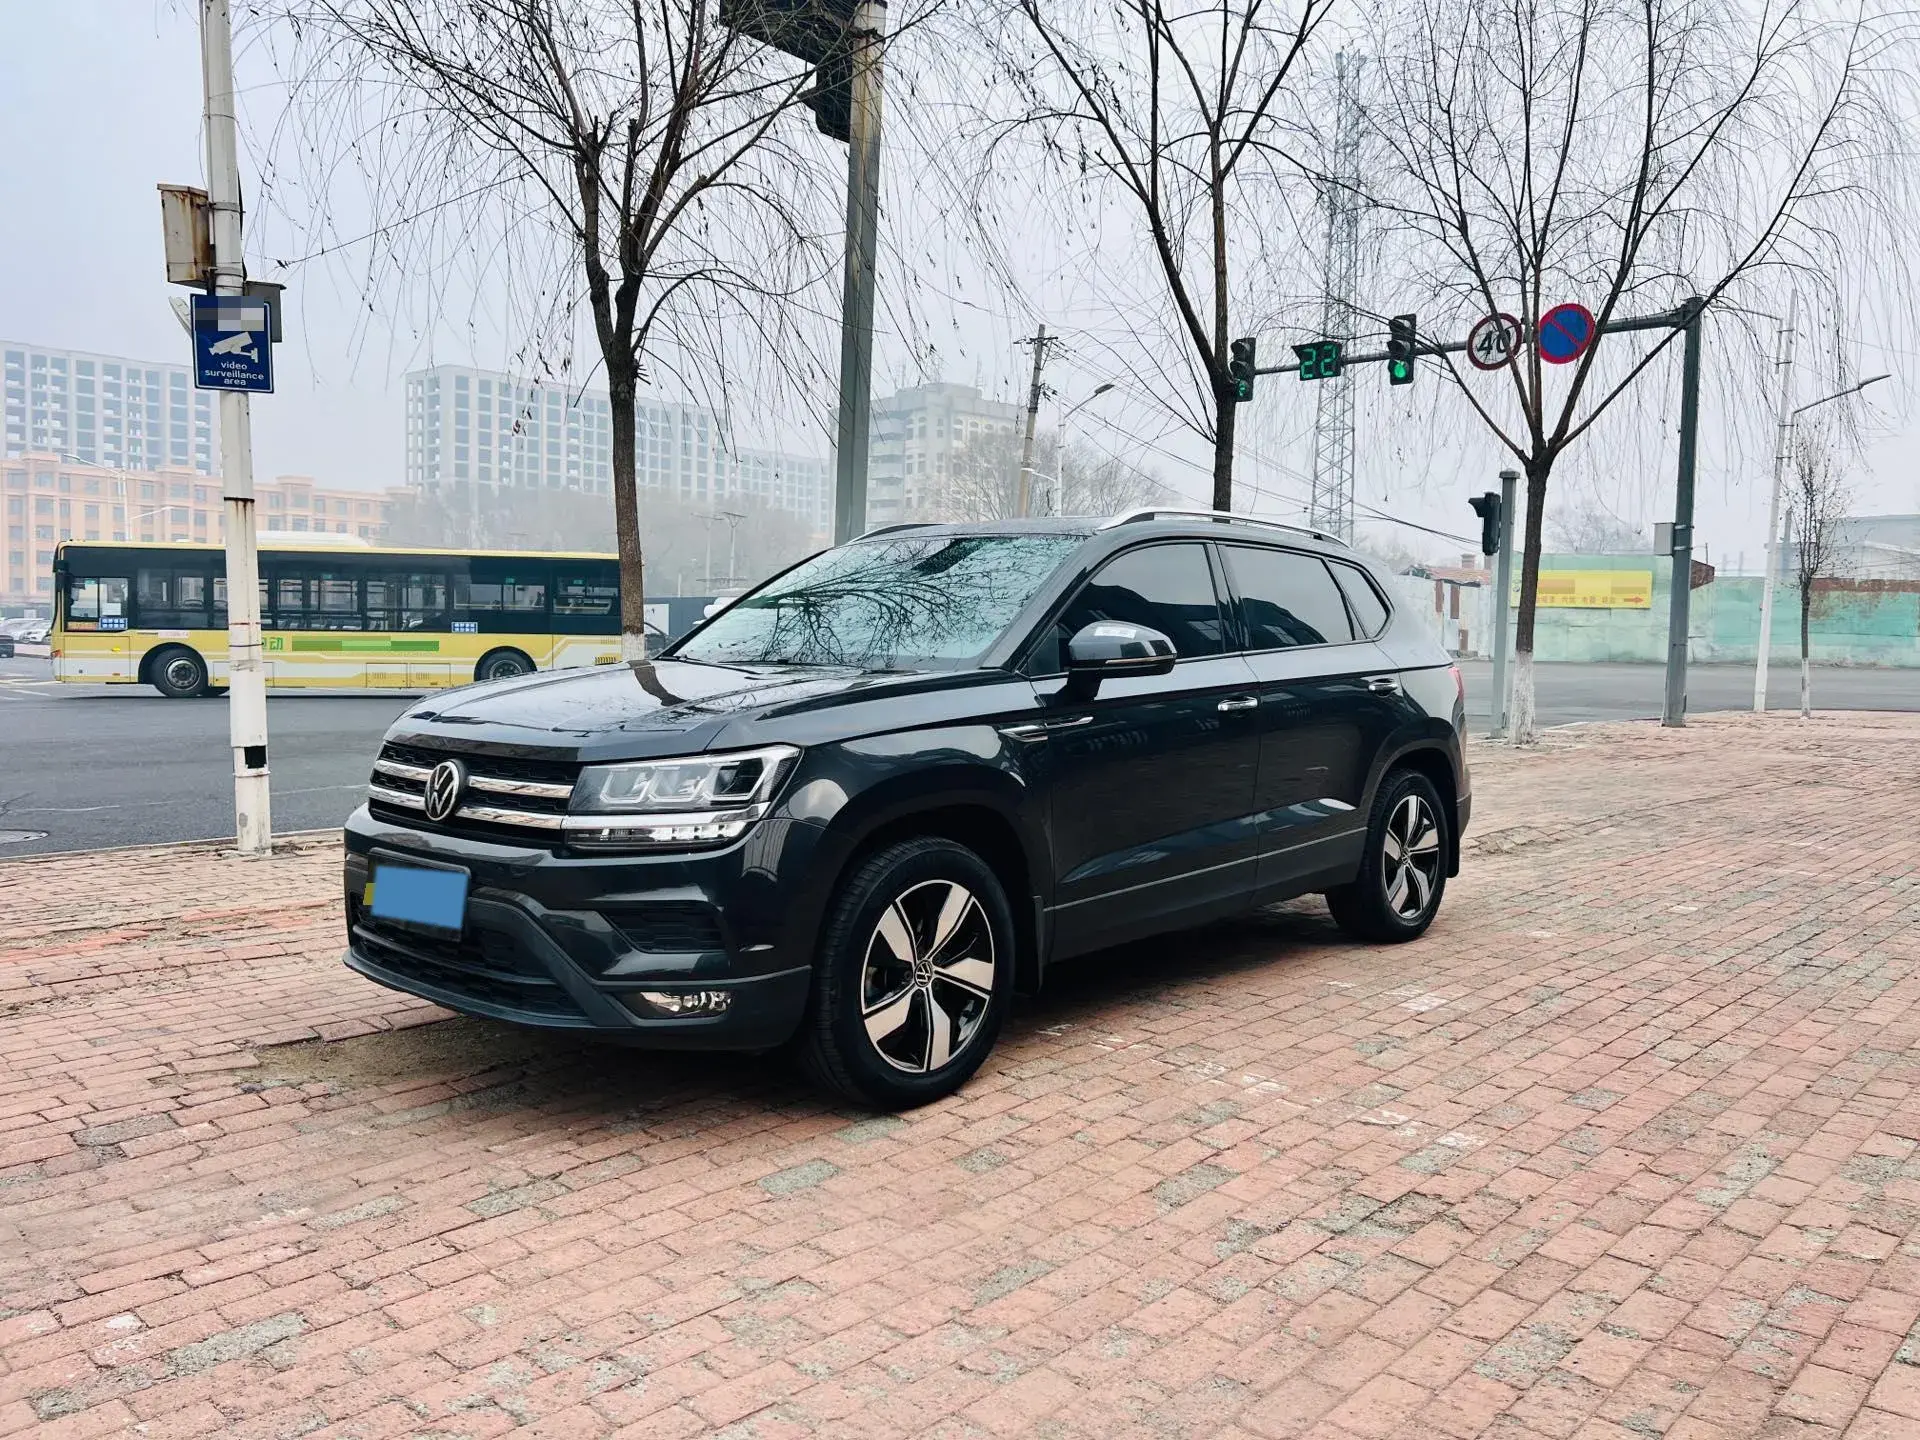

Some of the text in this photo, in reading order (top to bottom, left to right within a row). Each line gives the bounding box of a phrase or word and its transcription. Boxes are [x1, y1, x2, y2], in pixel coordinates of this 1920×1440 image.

[1477, 330, 1511, 354] 40
[221, 361, 247, 370] video
[1301, 345, 1336, 378] 22
[205, 369, 264, 380] surveillance
